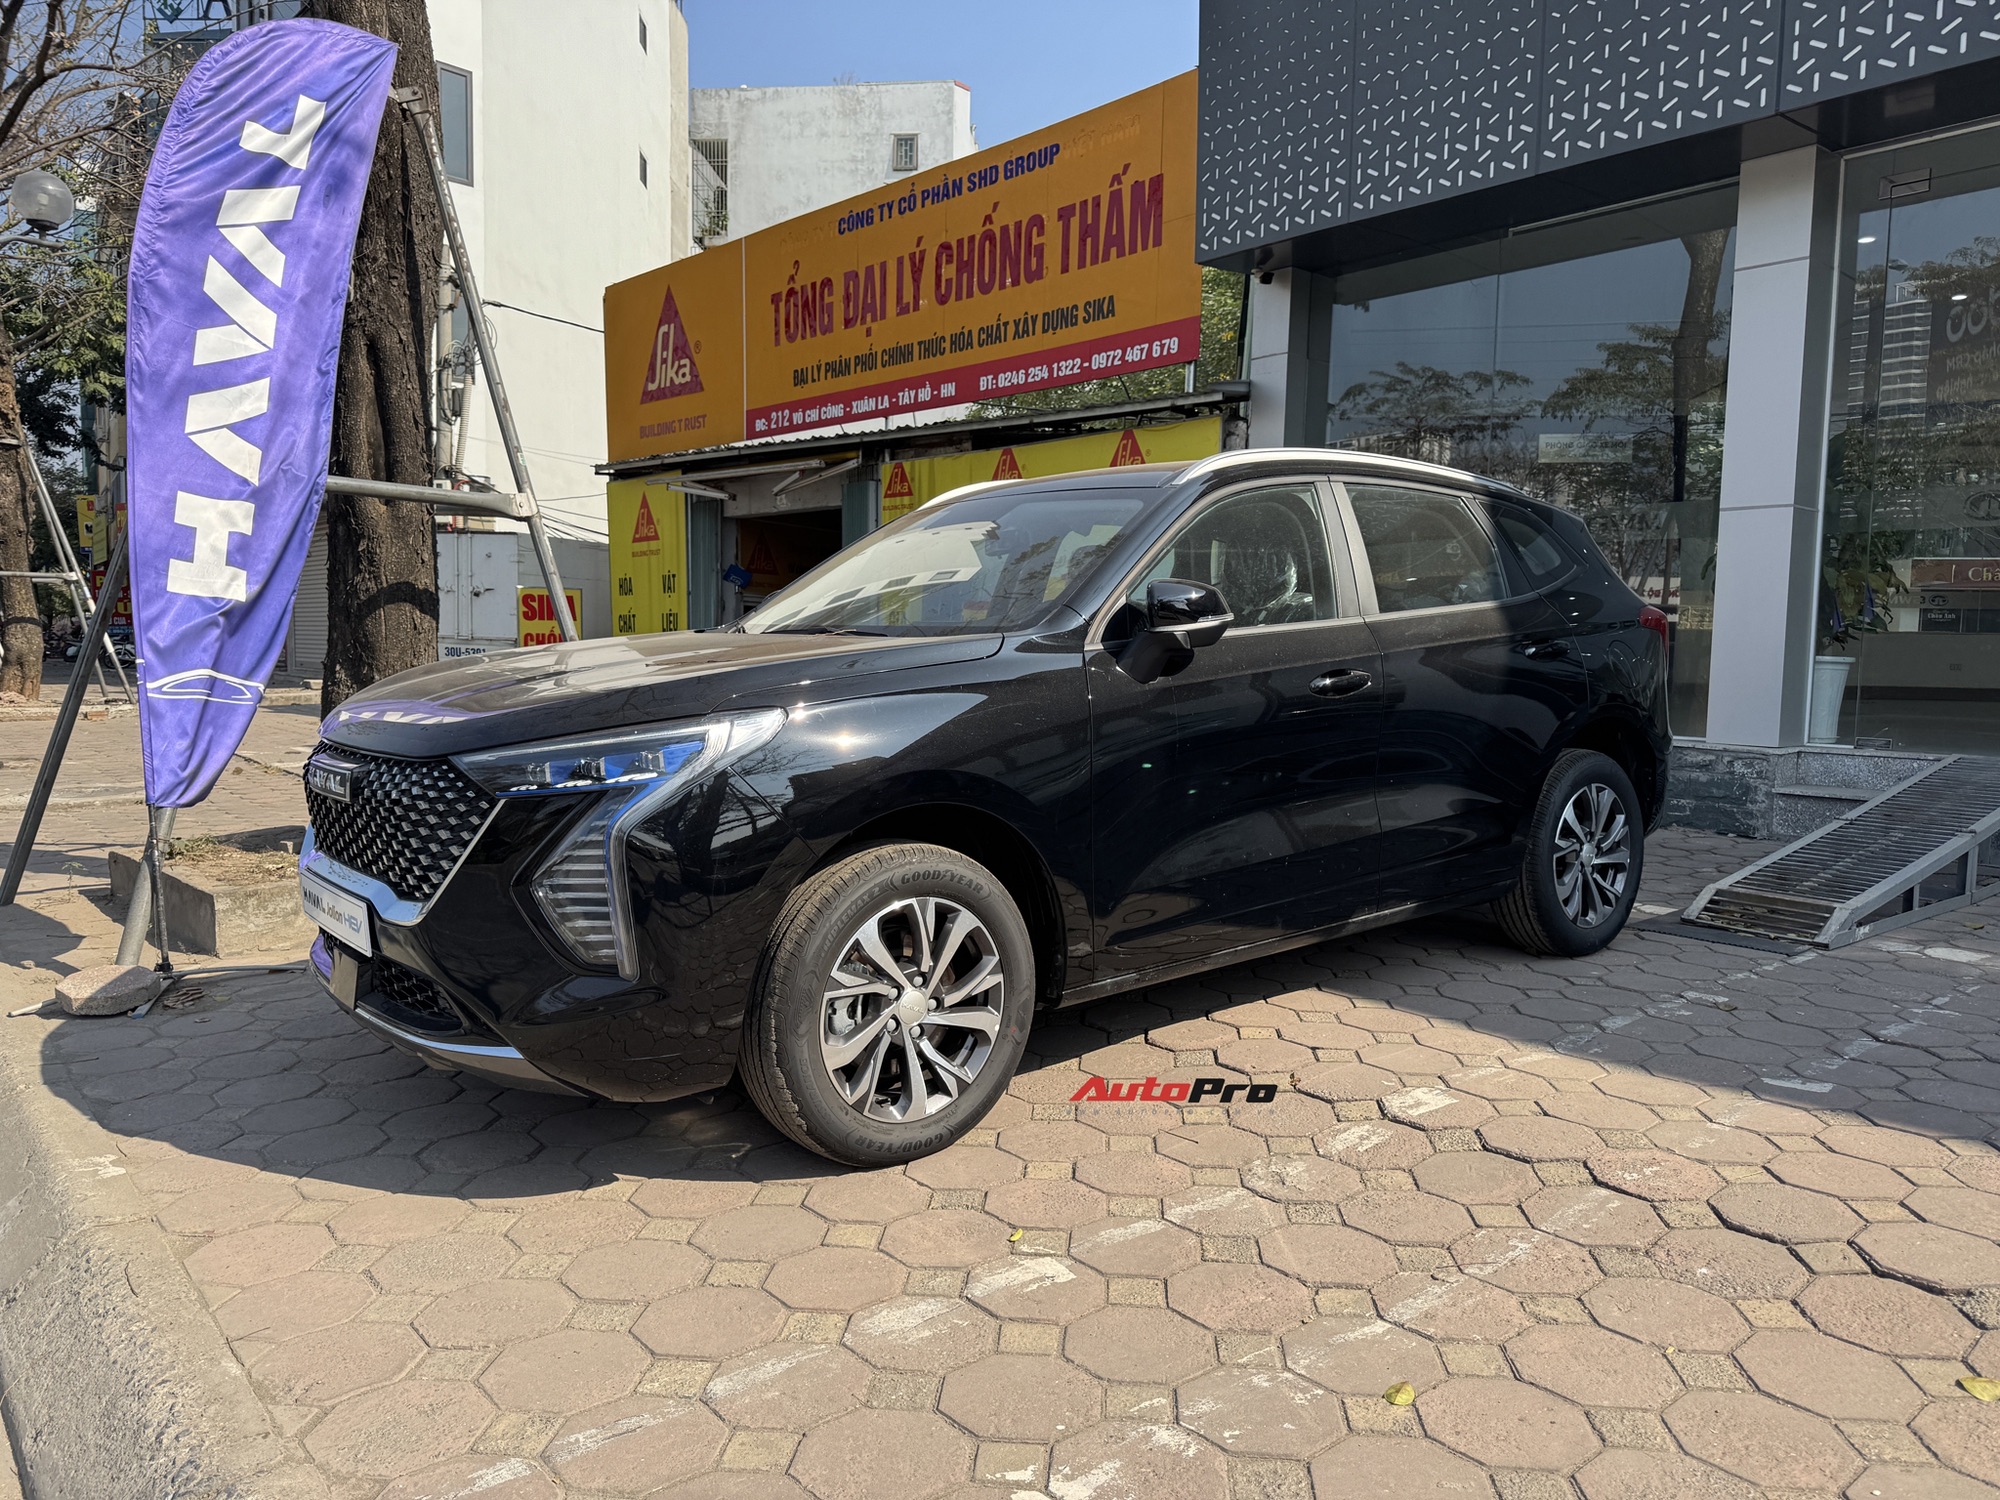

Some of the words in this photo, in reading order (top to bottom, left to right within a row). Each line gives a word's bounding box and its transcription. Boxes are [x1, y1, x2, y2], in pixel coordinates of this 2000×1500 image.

[838, 210, 874, 236] CÔNG
[878, 200, 895, 222] TY
[897, 182, 917, 216] CỔ
[920, 173, 963, 209] PHẦN
[967, 164, 999, 193] SHD
[1003, 143, 1061, 181] GROUP
[770, 259, 834, 347] TỔNG
[842, 260, 888, 338] ĐẠI
[896, 235, 927, 317] LÝ
[934, 201, 1046, 306] CHỐNG
[1057, 162, 1164, 275] THẤM
[166, 95, 327, 602] HAVAL
[793, 364, 809, 388] ĐẠI
[811, 358, 823, 382] LÝ
[824, 354, 851, 380] PHÂN
[854, 343, 878, 374] PHỐI
[881, 339, 914, 368] CHÍNH
[917, 331, 946, 361] THỨC
[949, 325, 974, 354] HÓA
[978, 313, 1010, 348] CHẤT
[1012, 311, 1039, 341] XÂY
[1042, 303, 1079, 336] DỰNG
[1082, 295, 1116, 324] SIKA
[647, 323, 691, 391] Sika
[979, 375, 997, 392] ĐT:
[998, 369, 1026, 389] 0246
[1027, 364, 1049, 382] 254
[1051, 357, 1081, 378] 1322
[1091, 349, 1122, 371] 0972
[1125, 343, 1149, 363] 467
[755, 418, 769, 432] ĐC:
[770, 409, 790, 429] 212
[792, 409, 803, 426] VÕ
[805, 404, 820, 423] CHÍ
[821, 403, 845, 420] CÔNG
[852, 395, 876, 415] XUÂN
[877, 394, 890, 410] LA
[898, 387, 916, 406] TÂY
[917, 381, 932, 401] HỒ
[940, 382, 956, 398] HN
[639, 419, 676, 439] BUILDING
[887, 468, 909, 494] Sika
[635, 508, 656, 538] Sika
[618, 573, 634, 597] HÓA
[662, 570, 677, 599] VẬT
[618, 607, 637, 633] CHẤT
[900, 868, 985, 895] GOODYEAR
[303, 886, 326, 914] HAVAL
[853, 1131, 944, 1155] GOODYEAR
